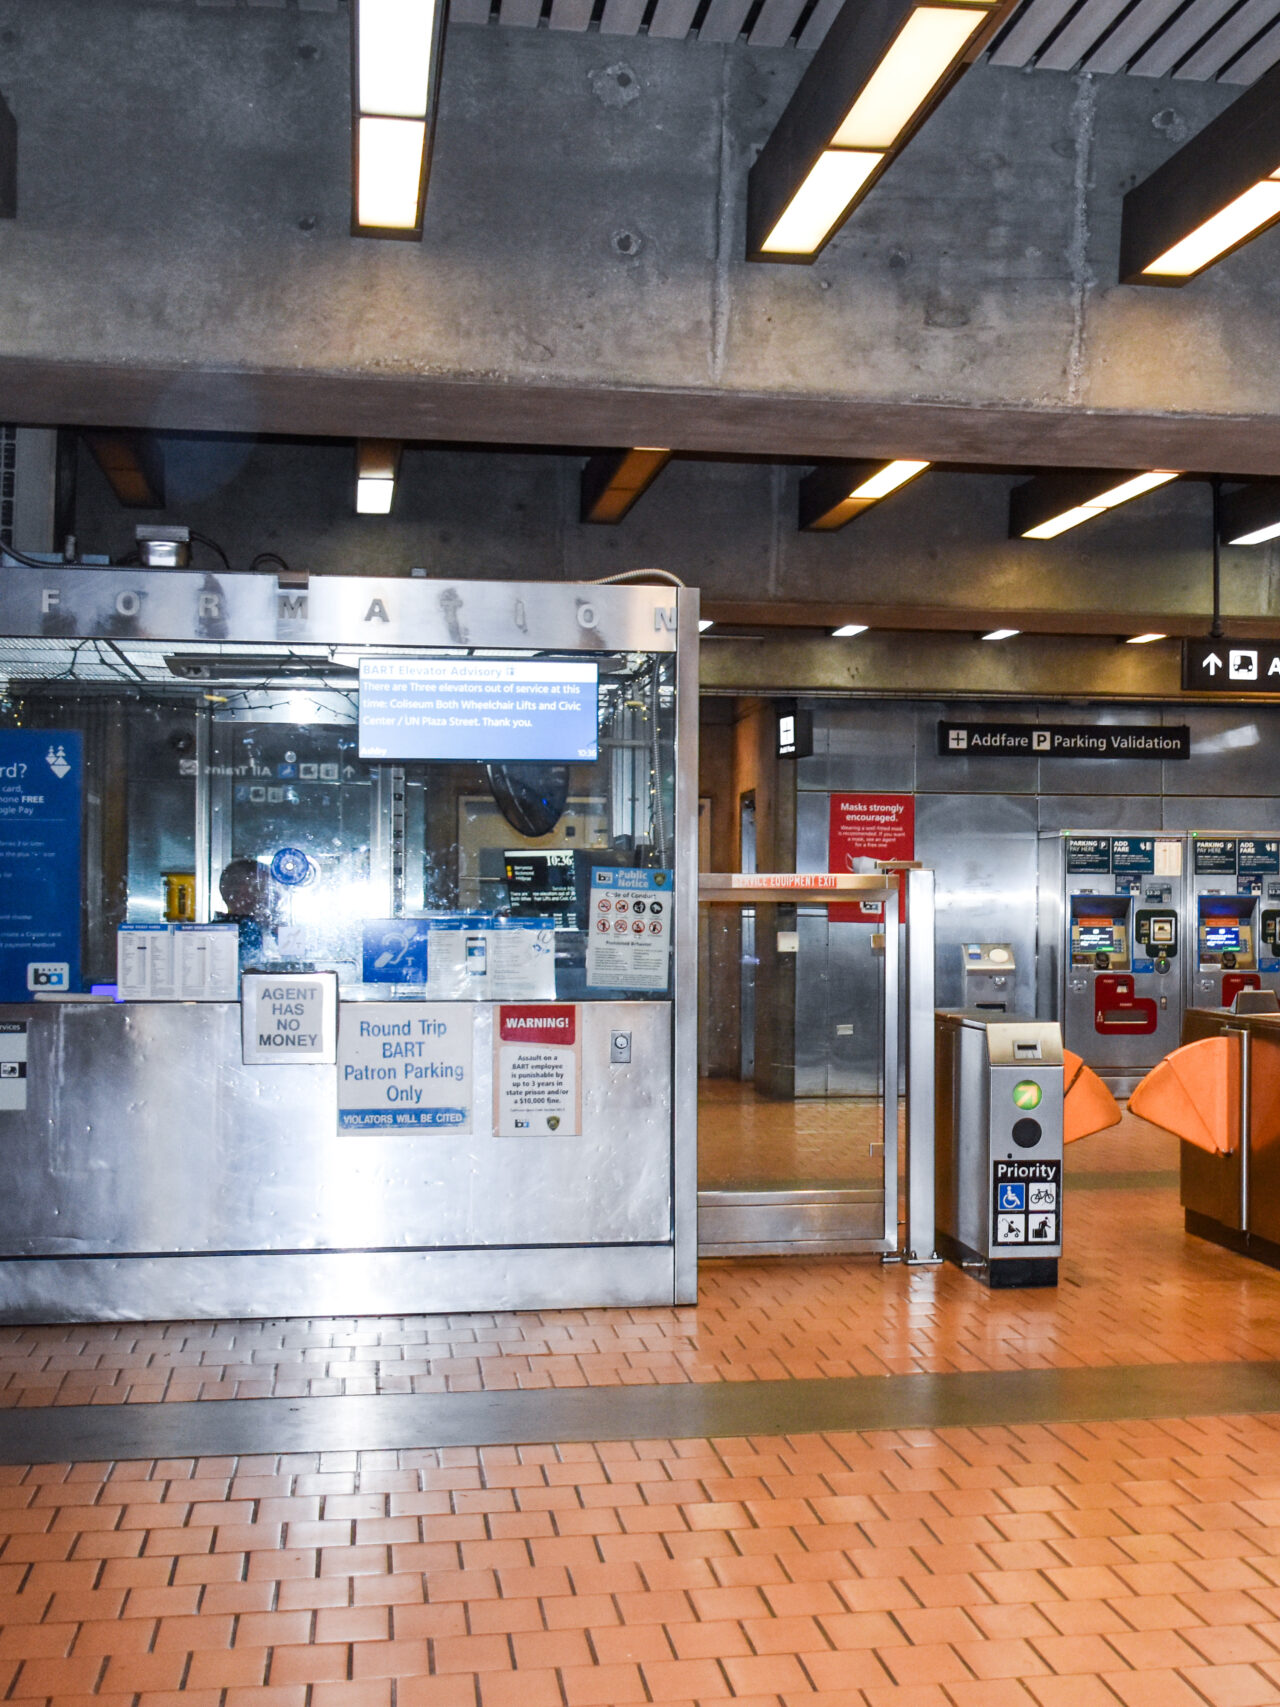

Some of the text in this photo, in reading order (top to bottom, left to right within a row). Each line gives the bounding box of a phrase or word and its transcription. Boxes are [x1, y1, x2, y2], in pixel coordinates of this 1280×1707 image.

[363, 665, 502, 678] BART Elevator Advisory
[363, 682, 580, 694] There are Three elevators out of service at this
[390, 699, 434, 709] Coliseum
[436, 700, 459, 709] Both
[461, 699, 514, 711] Wheelchair
[516, 701, 537, 711] Lifts
[539, 701, 557, 711] and
[558, 701, 582, 711] Civic
[363, 715, 396, 725] Center
[405, 716, 420, 726] UN
[422, 717, 447, 726] Plaza
[448, 717, 481, 727] Street.
[482, 717, 511, 727] Thank
[512, 718, 533, 729] you.
[971, 733, 1028, 747] Addfare
[1055, 735, 1106, 750] Parking
[1112, 735, 1181, 749] Validation
[840, 803, 904, 814] Masks strongly
[846, 813, 899, 823] encouraged.
[618, 870, 648, 880] Public
[771, 875, 815, 887] EQUIPMENT
[819, 875, 836, 887] EXIT
[618, 879, 649, 888] Notice
[262, 988, 317, 1000] AGENT
[272, 1003, 304, 1015] HAS
[277, 1018, 300, 1031] NO
[360, 1019, 447, 1038] Round Trip
[506, 1018, 569, 1029] WARNING!
[259, 1034, 317, 1046] MONEY
[382, 1041, 425, 1058] BART
[344, 1062, 464, 1081] Patron Parking
[386, 1085, 423, 1104] Only
[343, 1113, 463, 1124] VIOLATORS WILL BE CITED
[998, 1163, 1056, 1180] Priority
